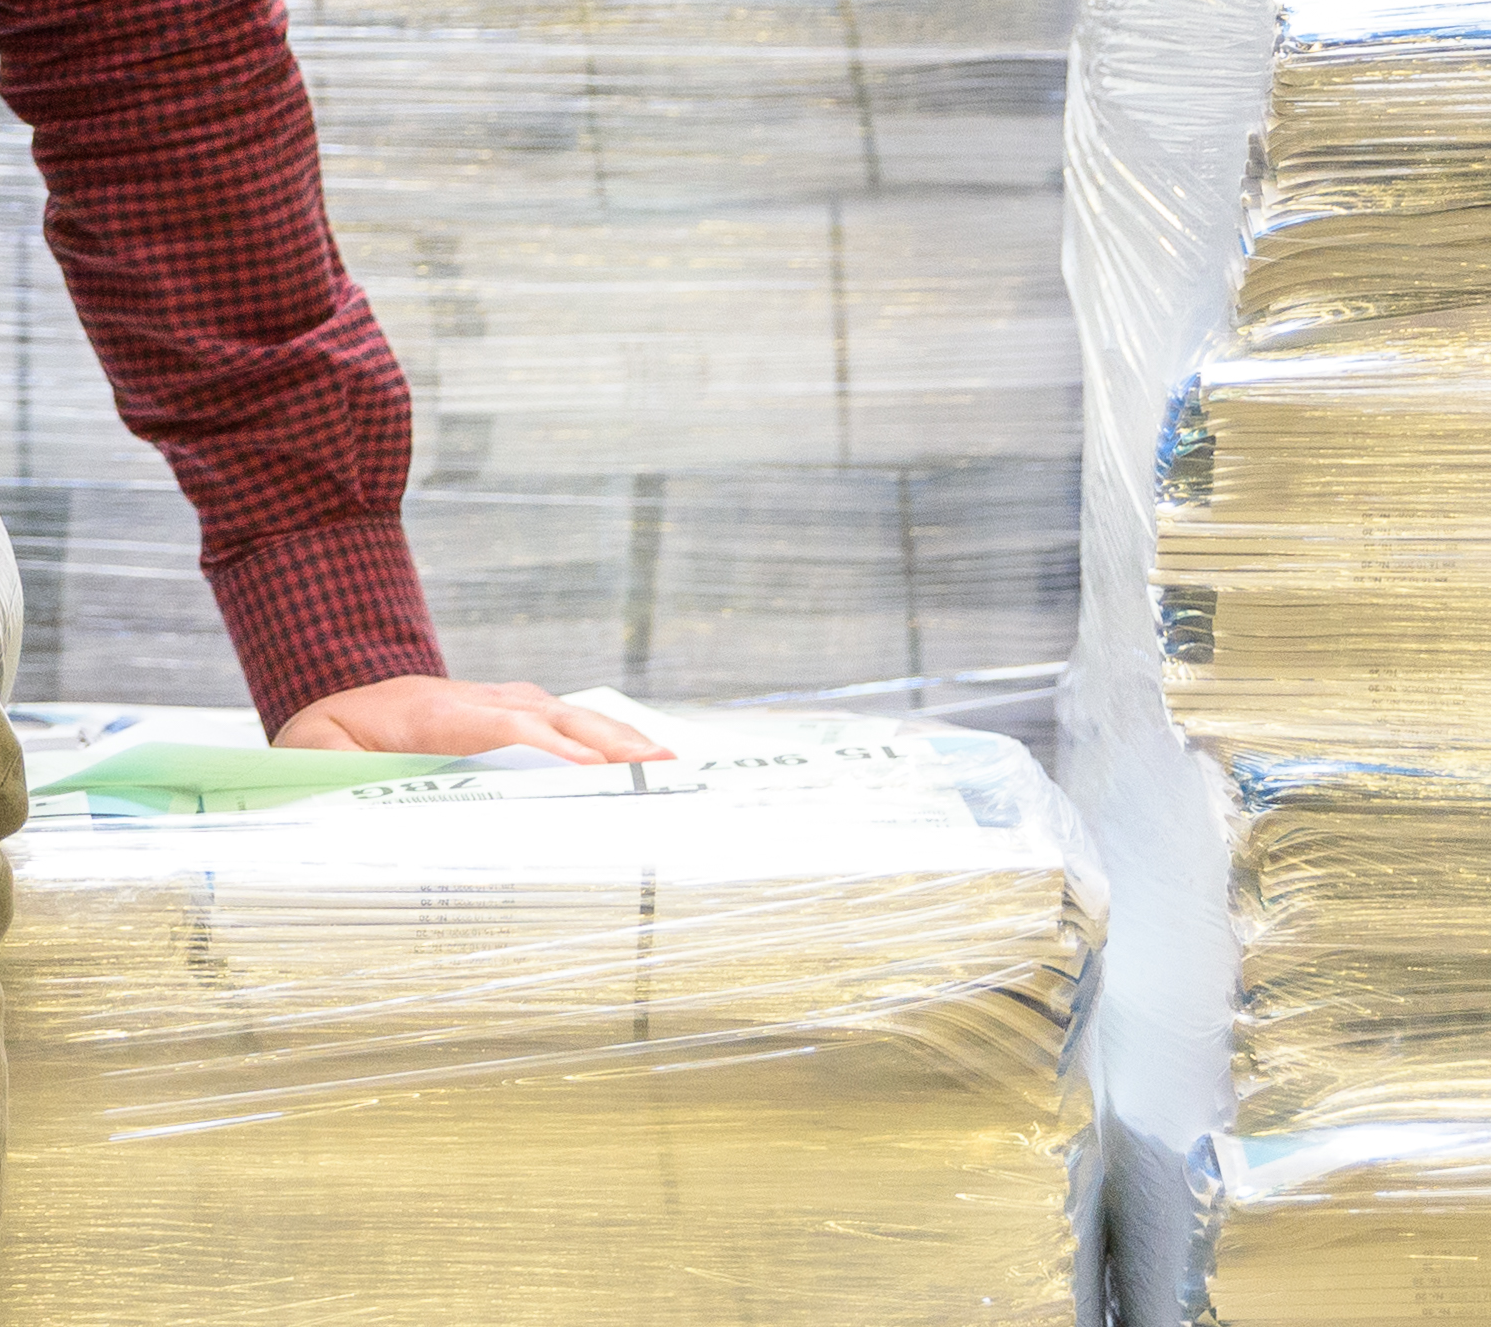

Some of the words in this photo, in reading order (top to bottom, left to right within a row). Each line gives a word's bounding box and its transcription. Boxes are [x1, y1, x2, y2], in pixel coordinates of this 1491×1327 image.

[698, 753, 809, 772] 907
[834, 745, 906, 761] 15
[351, 776, 482, 800] ZBG
